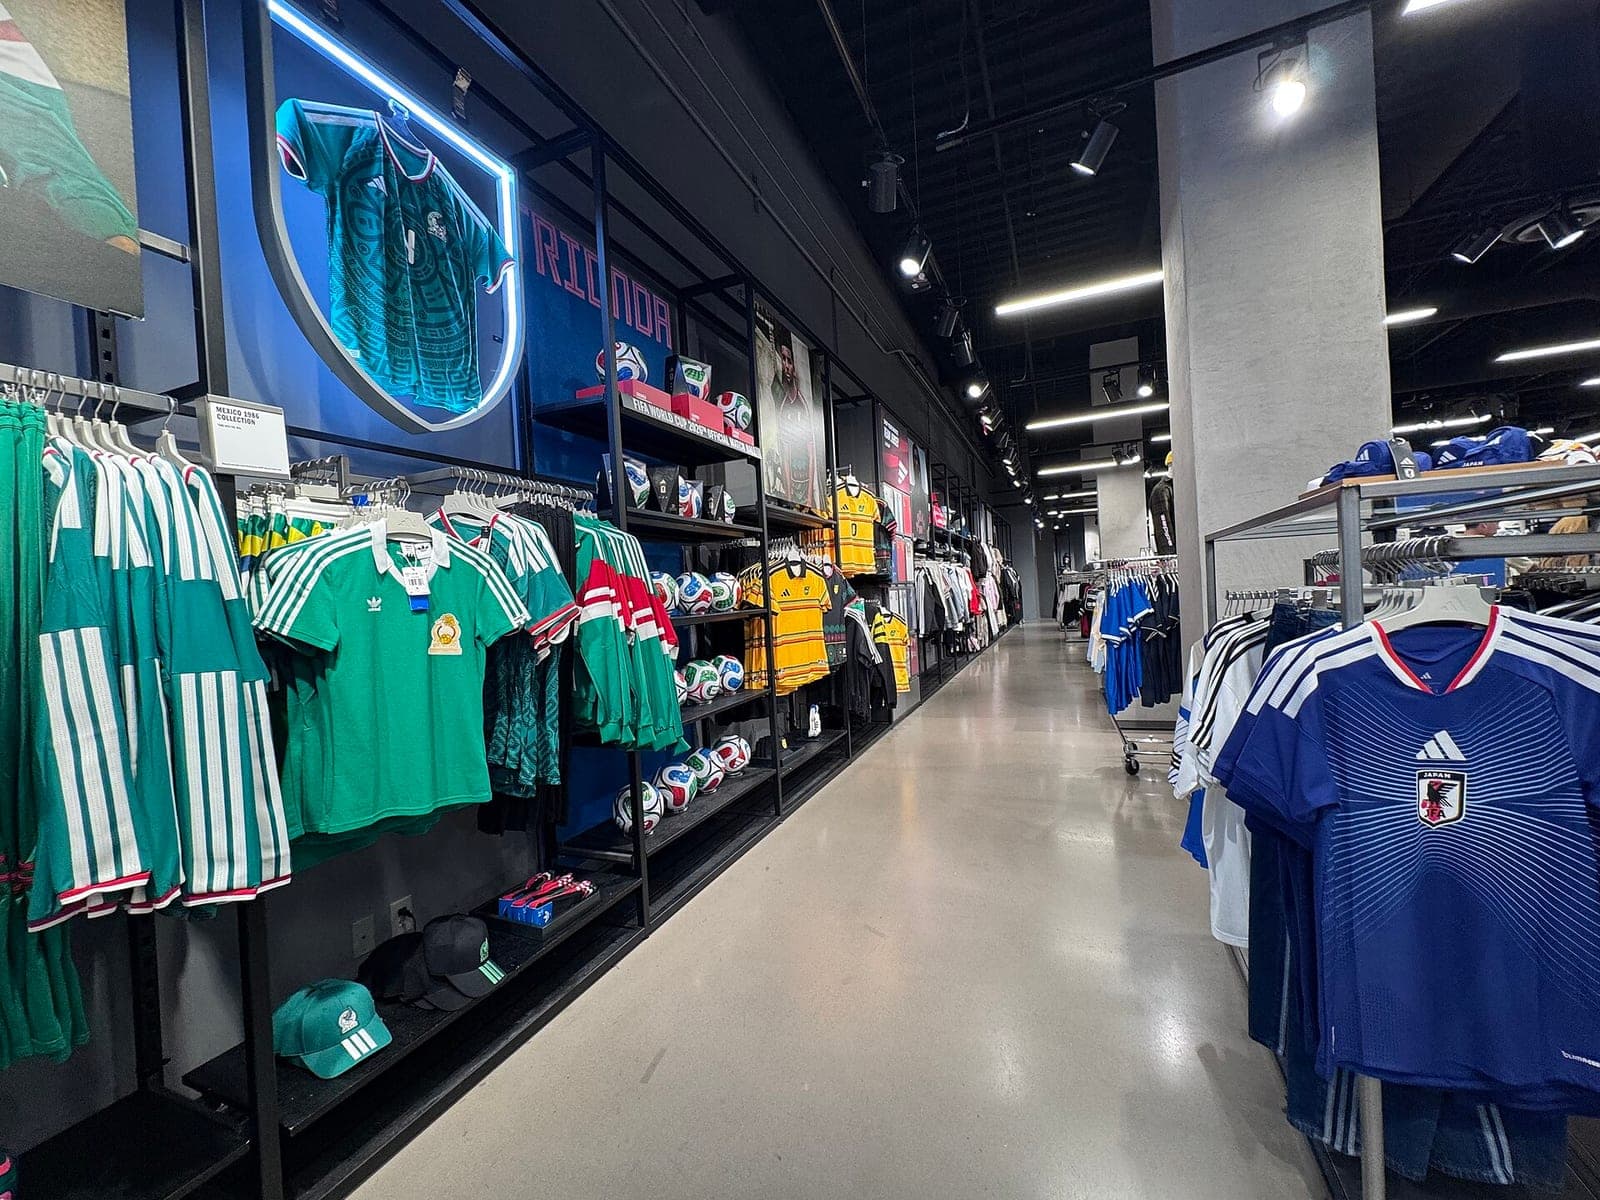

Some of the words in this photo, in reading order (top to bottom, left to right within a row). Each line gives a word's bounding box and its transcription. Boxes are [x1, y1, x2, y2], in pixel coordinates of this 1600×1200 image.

[519, 203, 672, 350] RIONDA
[215, 406, 242, 417] MEXICO
[243, 410, 260, 420] 1986
[216, 413, 256, 425] COLLECTION
[632, 397, 650, 415] FIFA
[648, 404, 674, 423] WORLD
[674, 415, 687, 429] CUP
[1461, 460, 1484, 468] JAPAN
[1424, 809, 1446, 818] JFA
